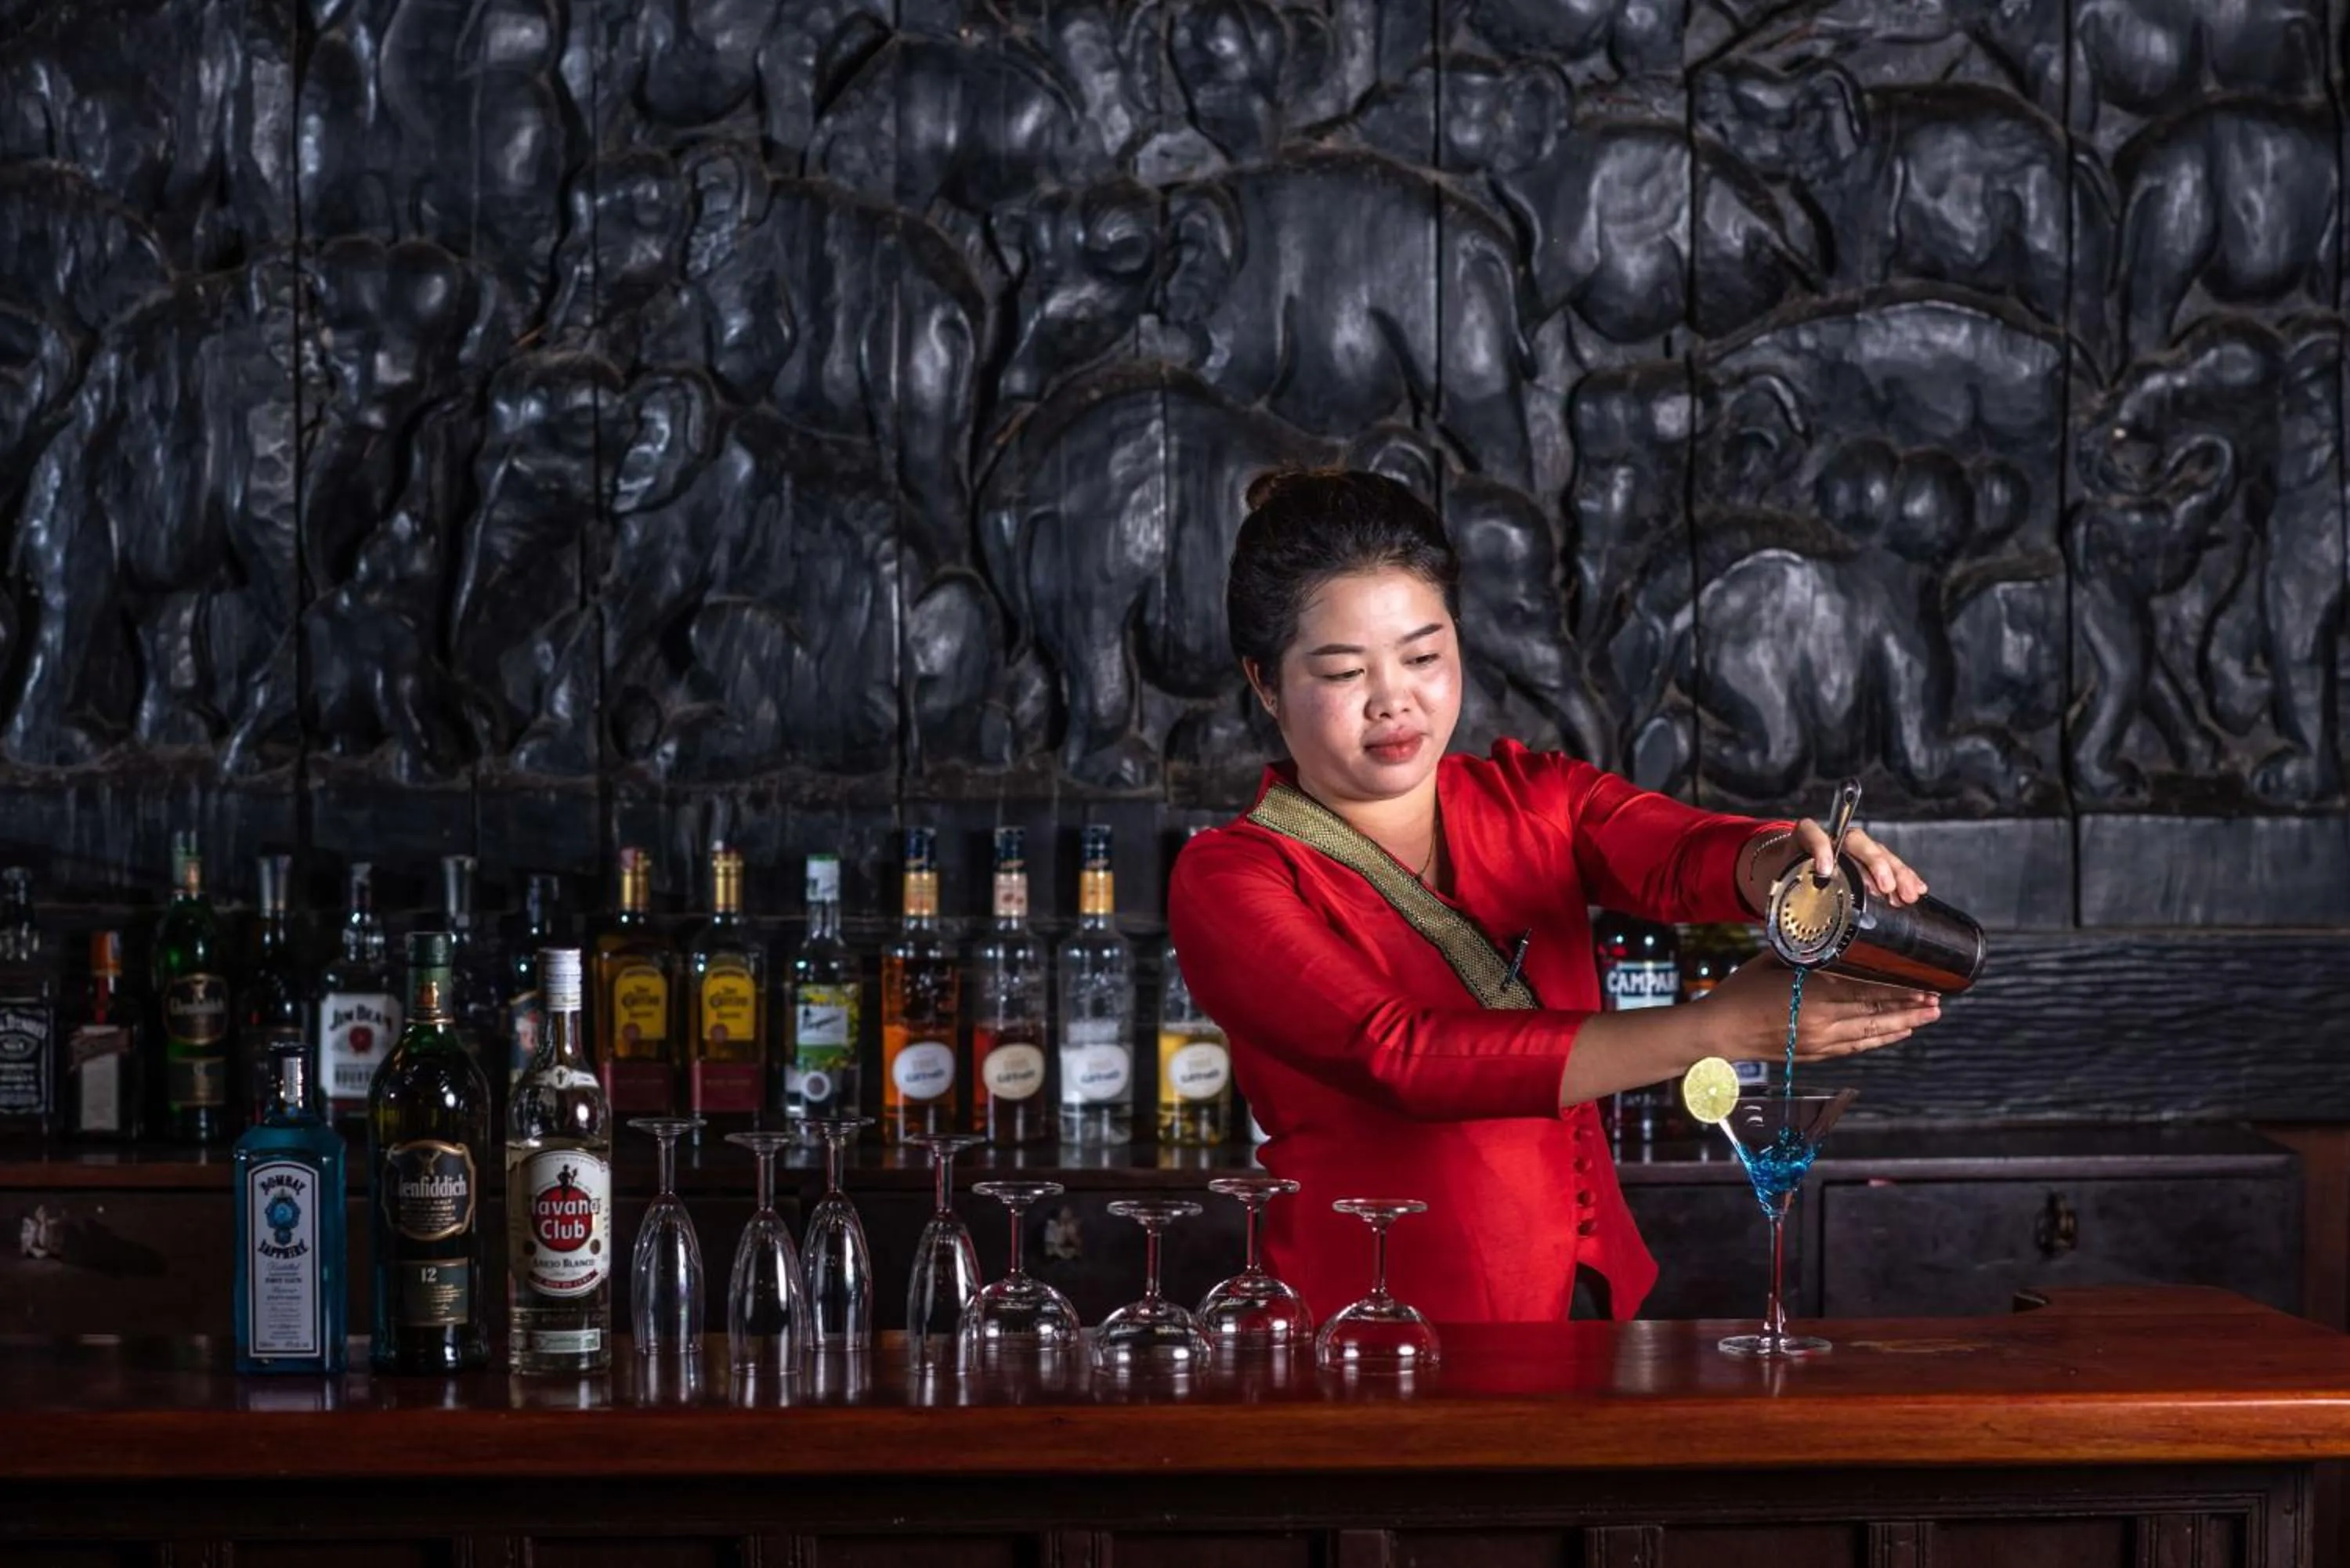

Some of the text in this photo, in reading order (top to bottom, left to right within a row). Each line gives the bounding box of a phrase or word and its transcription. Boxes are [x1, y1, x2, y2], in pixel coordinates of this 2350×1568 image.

[260, 1175, 306, 1195] BOMBAY
[392, 1174, 468, 1198] lenfiddich
[540, 1219, 585, 1239] Club
[258, 1239, 309, 1259] SAPPHIRE
[421, 1266, 437, 1283] 12
